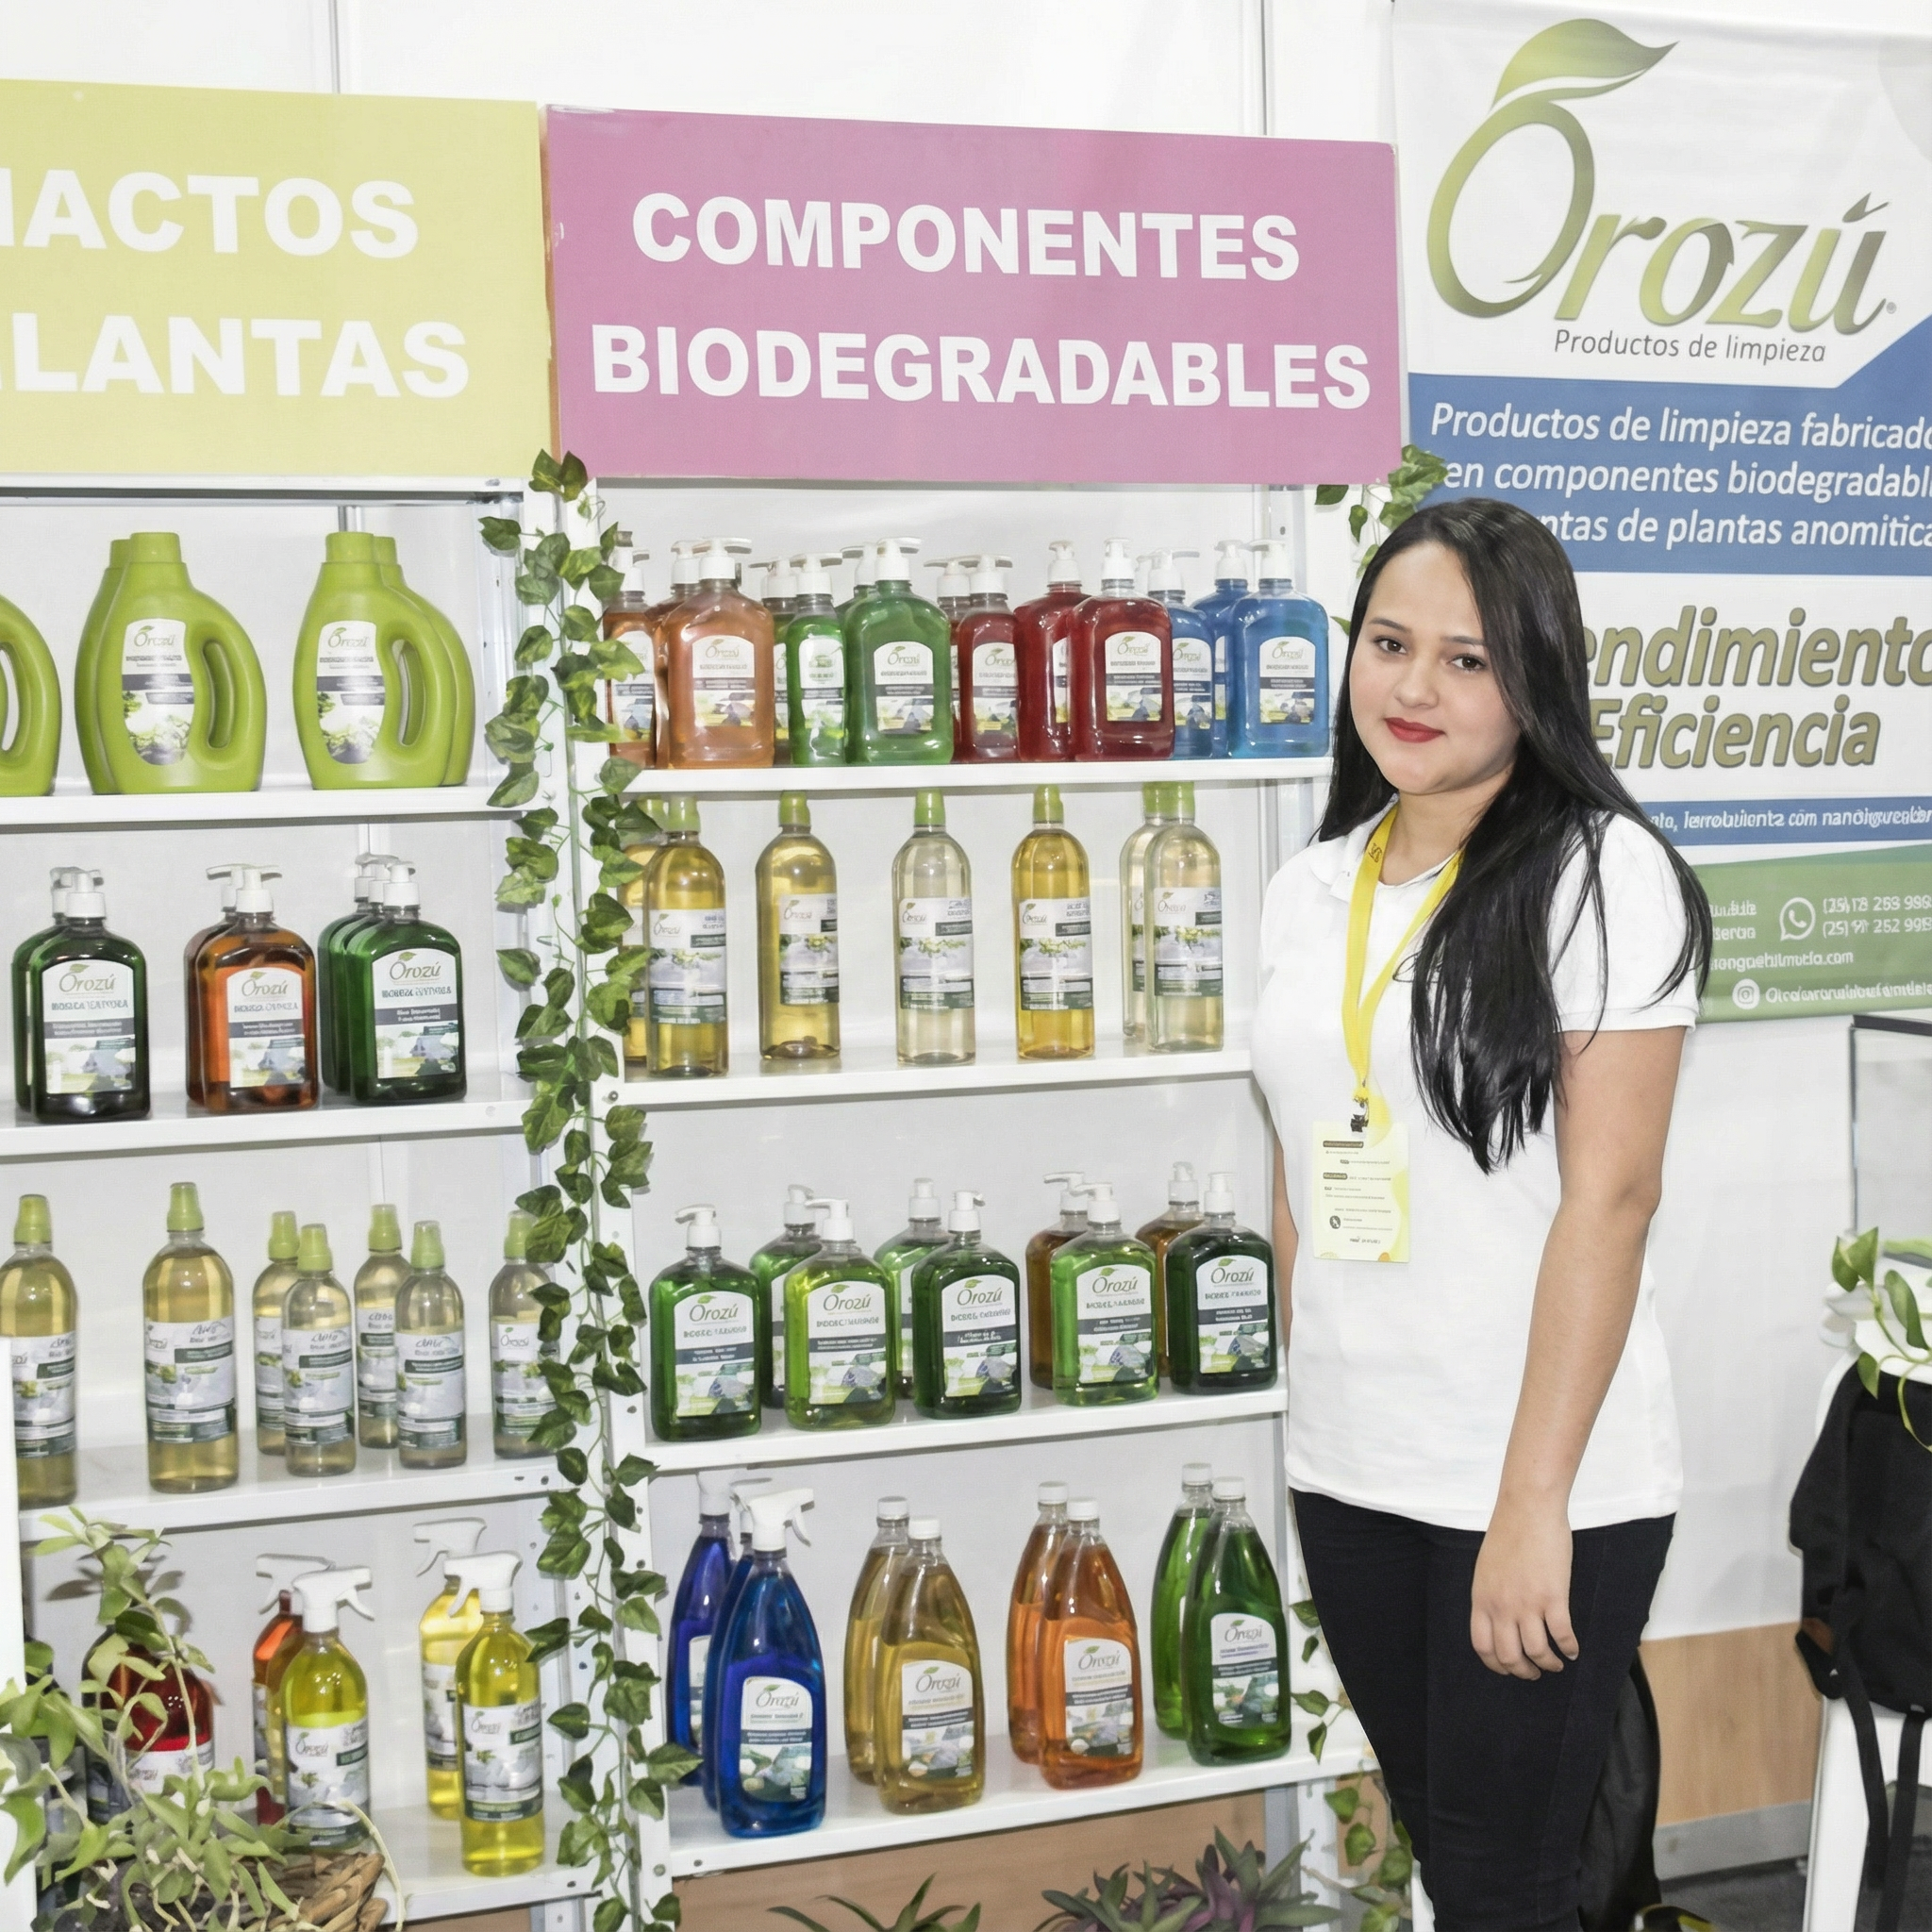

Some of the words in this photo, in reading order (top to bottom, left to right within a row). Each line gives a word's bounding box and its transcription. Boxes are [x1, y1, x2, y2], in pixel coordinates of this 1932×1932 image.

[1426, 80, 1890, 336] Orozú
[631, 192, 1300, 281] COMPONENTES
[0, 311, 470, 399] LANTAS
[591, 324, 1372, 410] BIODEGRADABLES
[1555, 329, 1679, 358] Productos
[1689, 334, 1717, 358] de
[1725, 335, 1826, 366] limpieza
[1431, 402, 1601, 441] Productos
[1609, 407, 1651, 441] de
[1659, 408, 1791, 451] limpieza
[1443, 461, 1484, 490] en
[1494, 462, 1719, 498] componentes
[1728, 460, 1932, 504] biodegradabl
[1536, 510, 1609, 541] ntas
[1617, 508, 1657, 542] de
[1666, 510, 1783, 550] plantas
[1590, 692, 1881, 769] Eficiencia
[58, 971, 117, 992] Orozú
[390, 959, 441, 980] Orozú
[823, 1292, 872, 1312] Orozú
[957, 1287, 1003, 1306] Orozú
[1091, 1275, 1139, 1294] Orozú
[689, 1303, 739, 1323] Orozú
